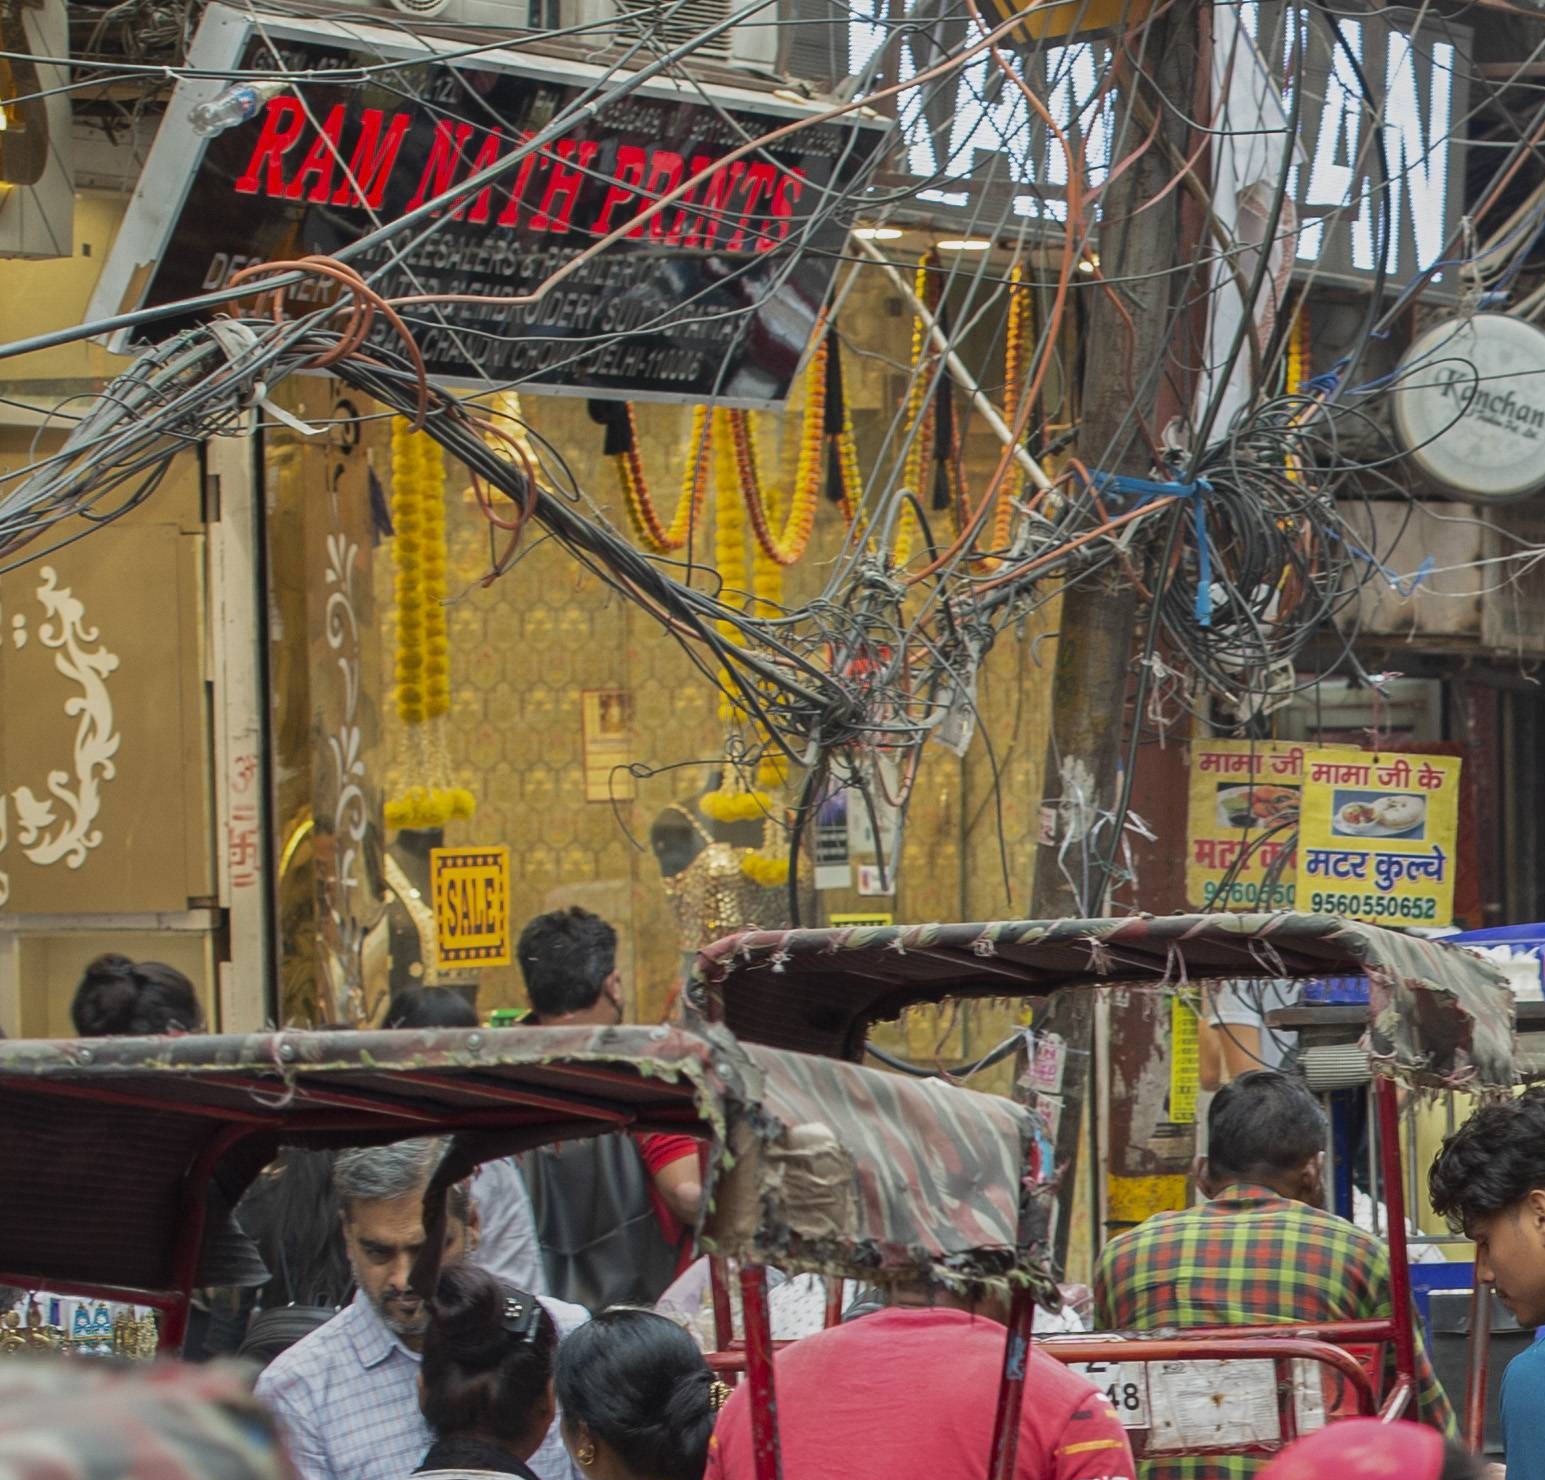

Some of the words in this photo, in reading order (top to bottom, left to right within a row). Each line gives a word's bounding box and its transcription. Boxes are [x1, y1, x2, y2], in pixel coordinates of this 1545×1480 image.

[234, 96, 412, 212] RAM
[404, 118, 599, 234] NATH
[589, 145, 807, 253] PRINTS
[1199, 752, 1263, 774] मामा
[1269, 747, 1304, 776] जी
[1311, 763, 1370, 786] मामा
[1376, 759, 1412, 788] जी
[1418, 762, 1446, 790] के
[1305, 849, 1371, 880] मटर
[1374, 845, 1447, 891] कुल्चे
[447, 877, 496, 937] SALE
[1310, 892, 1437, 919] 9560550652
